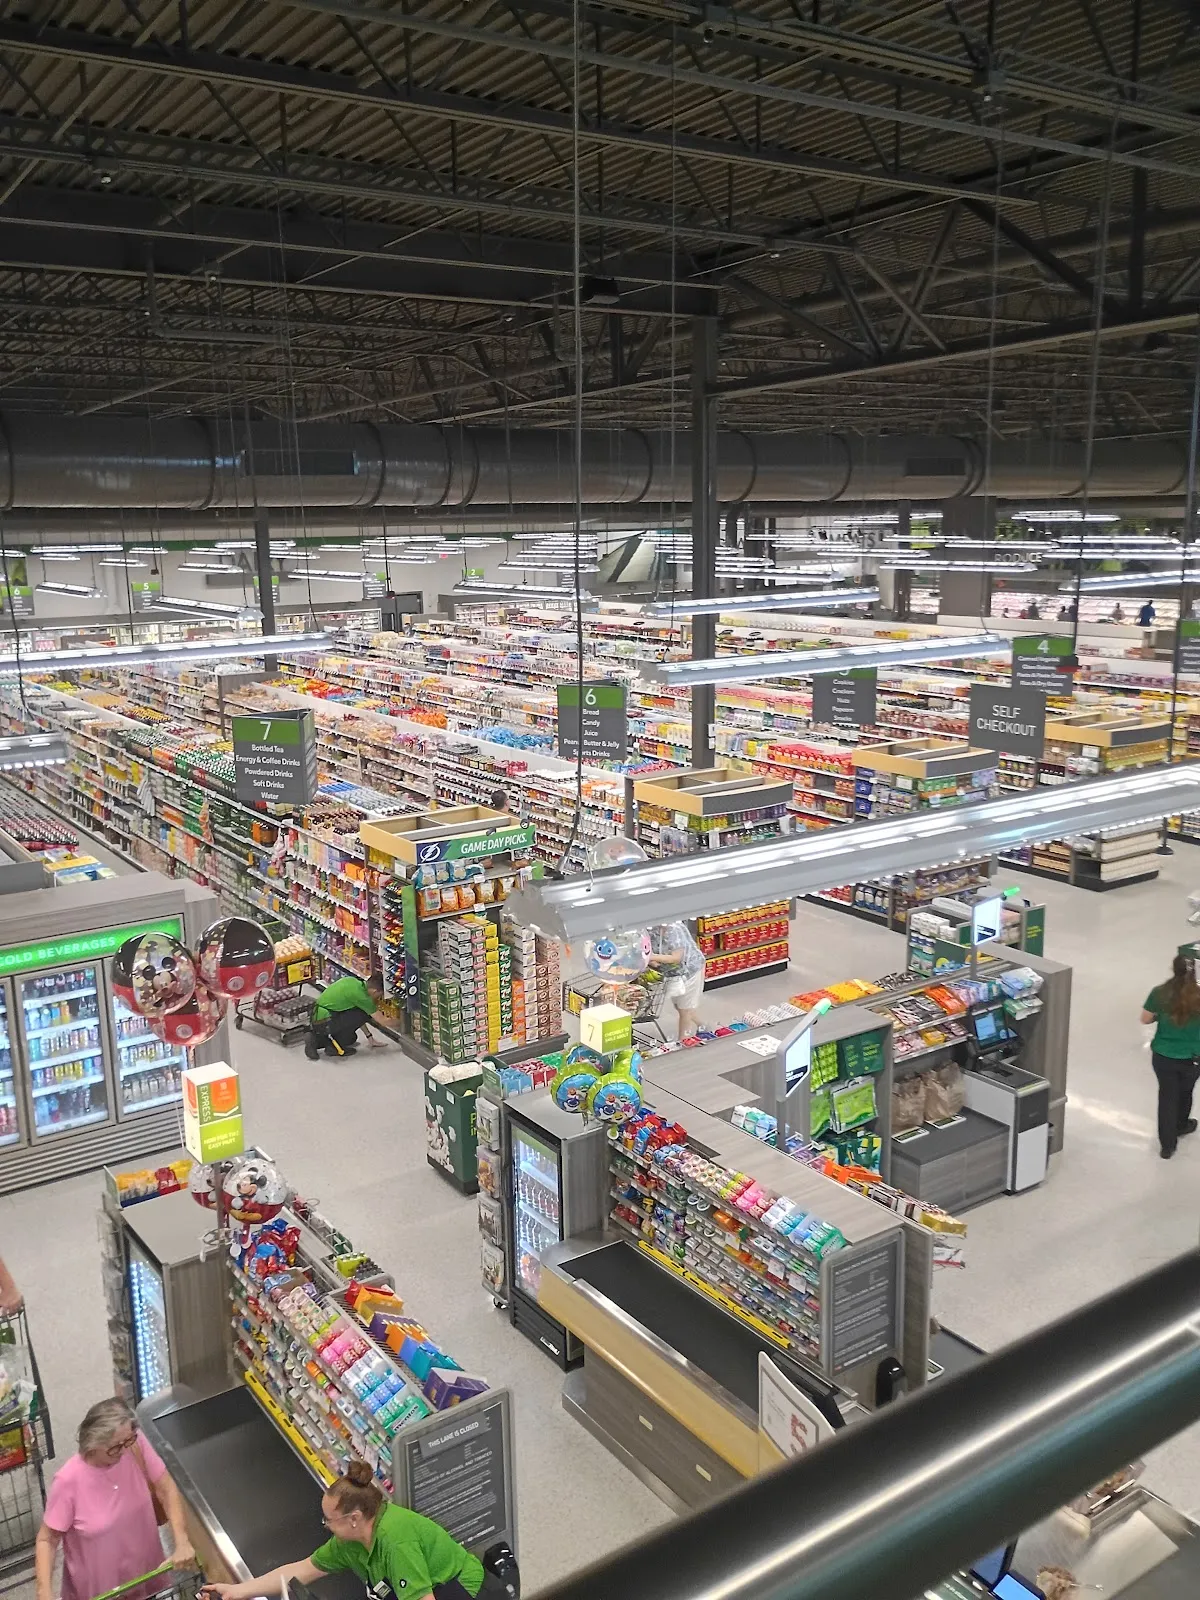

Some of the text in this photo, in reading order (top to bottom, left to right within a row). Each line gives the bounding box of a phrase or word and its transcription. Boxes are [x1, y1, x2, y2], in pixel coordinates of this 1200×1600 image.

[13, 588, 21, 596] 6
[143, 582, 150, 590] 5
[1036, 639, 1051, 654] 4
[585, 688, 597, 706] 6
[582, 708, 600, 716] Bread
[992, 704, 1021, 719] SELF
[582, 718, 600, 728] Candy
[976, 717, 1037, 737] CHECKOUT
[260, 720, 272, 741] 7
[583, 729, 599, 737] Juice
[251, 743, 284, 754] Bottled Tea
[583, 739, 602, 747] Butter
[607, 741, 620, 749] Jelly
[235, 754, 257, 764] Energy
[261, 756, 282, 765] Coffee
[281, 758, 301, 767] Drinks
[244, 767, 294, 778] Powdered Drinks
[252, 779, 285, 789] Soft Drinks
[260, 791, 280, 800] Water
[460, 832, 528, 854] GAME DAY PICKS.
[38, 937, 116, 959] BEVERAGES
[587, 1023, 595, 1042] 7
[200, 1084, 211, 1123] EXPRESS
[427, 1421, 480, 1449] THIS LANE IS CLOSED
